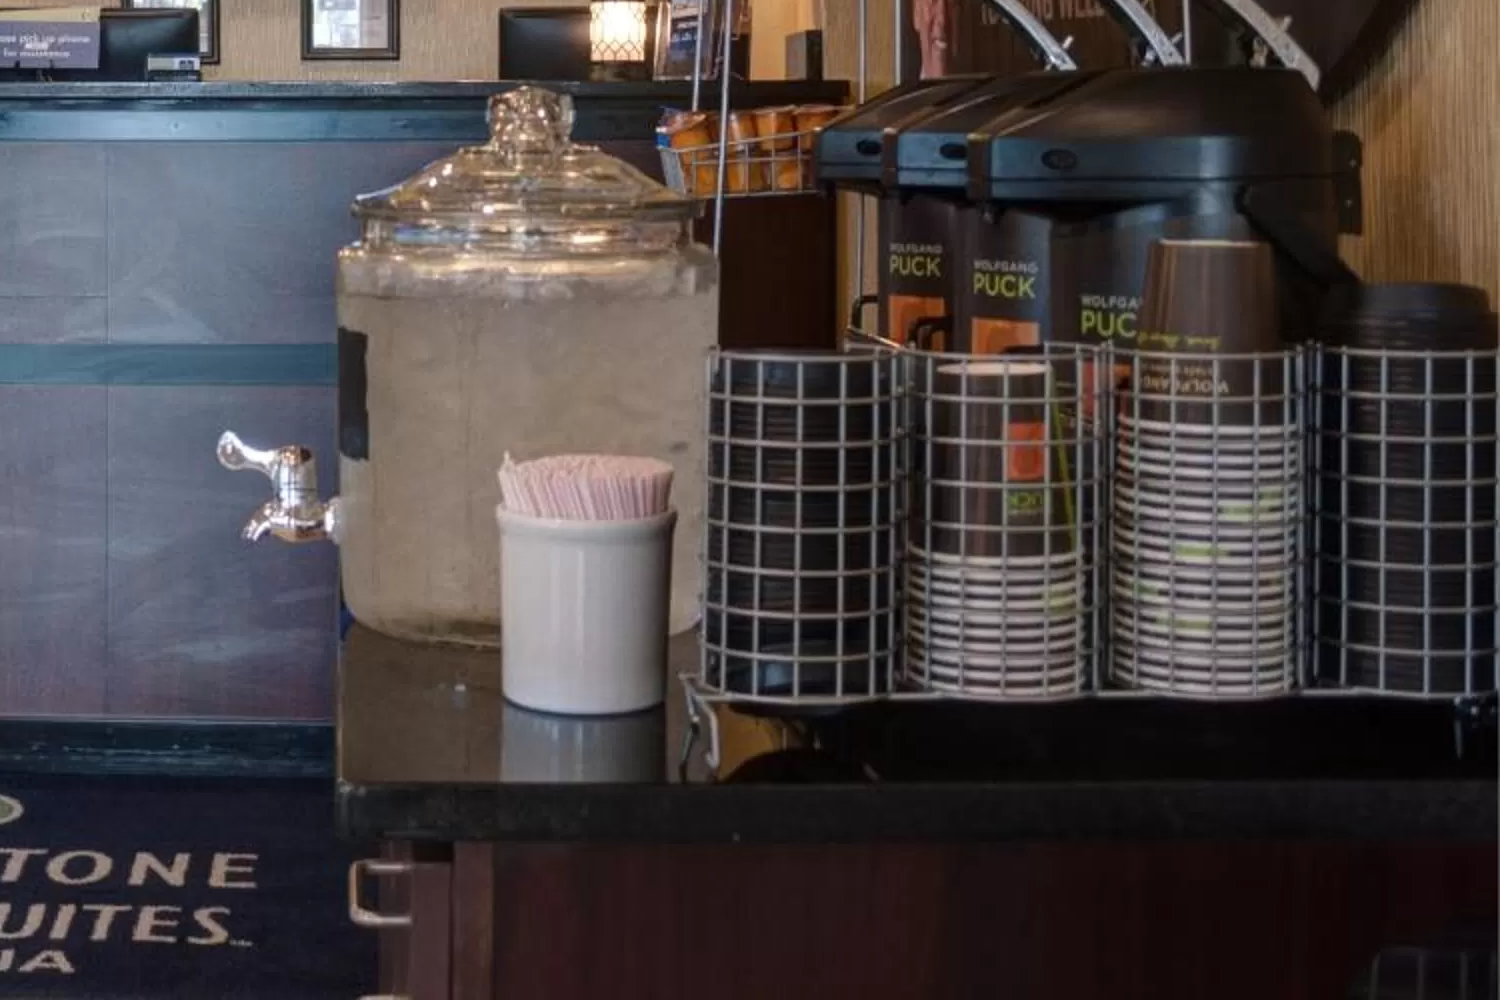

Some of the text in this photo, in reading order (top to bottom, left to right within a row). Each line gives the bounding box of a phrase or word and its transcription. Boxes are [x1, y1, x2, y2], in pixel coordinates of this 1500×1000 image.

[889, 242, 943, 255] WOLFGANG
[889, 255, 942, 278] PUCK
[973, 259, 1039, 273] WOLFGANG
[972, 273, 1037, 299] PUCK
[1080, 294, 1141, 309] WOLFGA
[1080, 309, 1138, 338] PUC
